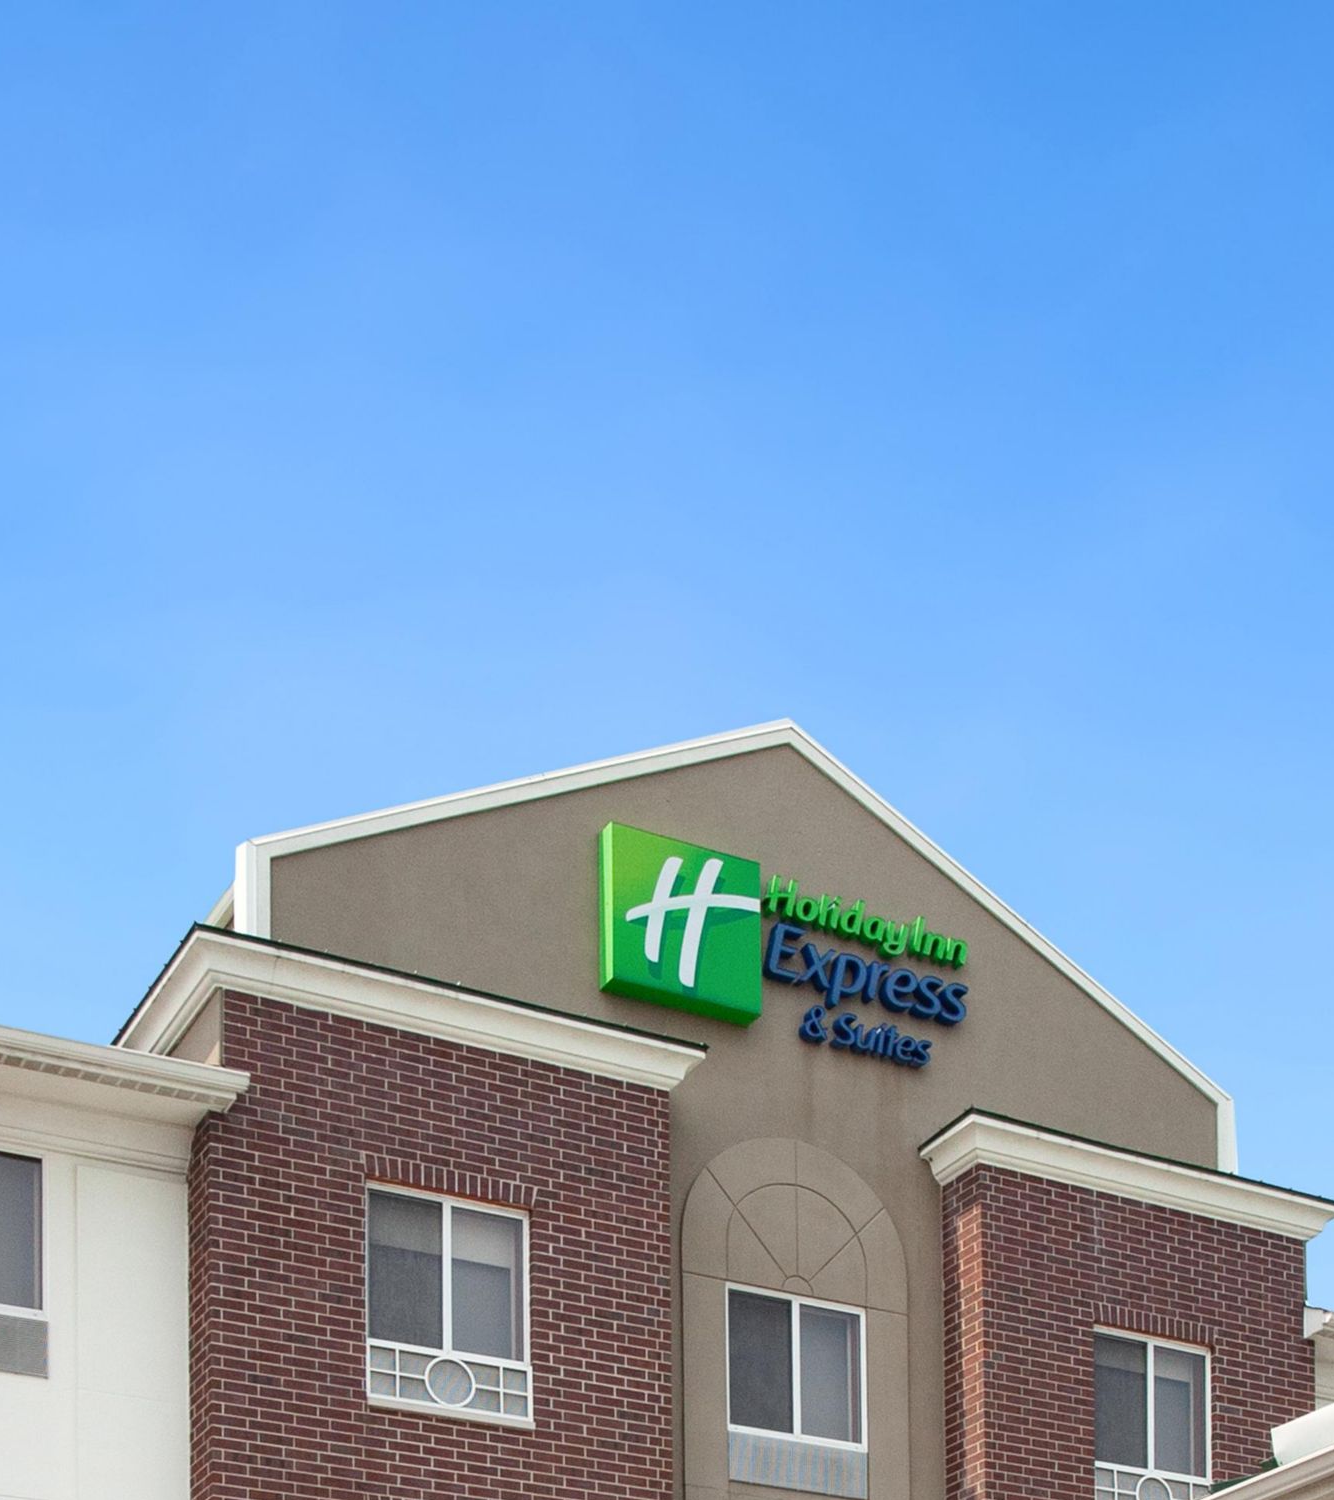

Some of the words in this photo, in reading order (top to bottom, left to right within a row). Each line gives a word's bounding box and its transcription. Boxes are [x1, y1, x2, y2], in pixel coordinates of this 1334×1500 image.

[763, 922, 968, 1025] Express
[798, 1005, 827, 1045] &
[831, 1012, 932, 1068] Suites
